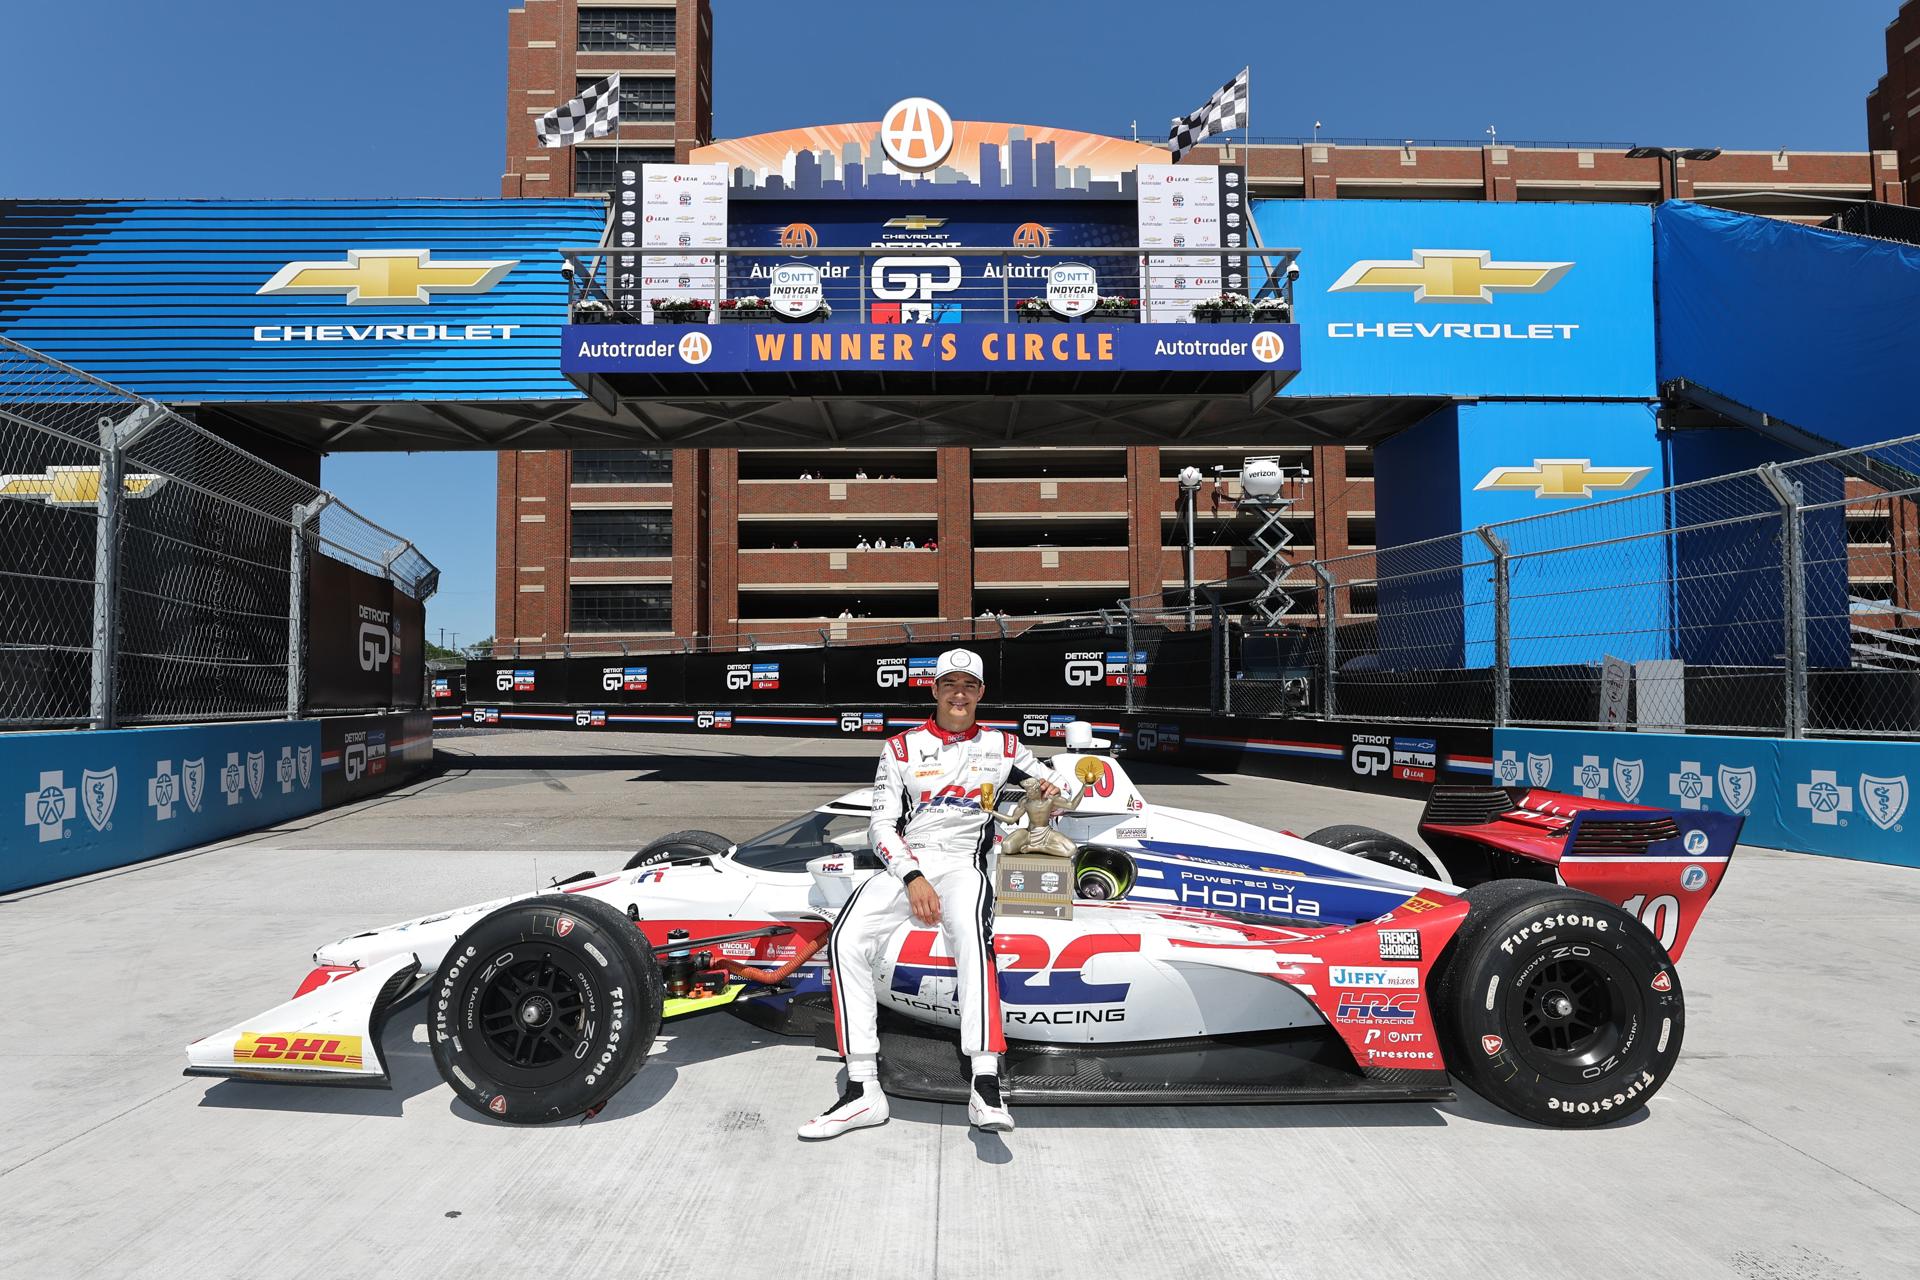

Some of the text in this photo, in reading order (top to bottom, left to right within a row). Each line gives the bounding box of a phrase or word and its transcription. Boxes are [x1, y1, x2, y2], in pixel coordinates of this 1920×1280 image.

[791, 273, 814, 282] NTT
[871, 256, 962, 300] GP
[1067, 273, 1090, 282] NTT
[773, 286, 819, 295] INDYCAR
[1049, 286, 1094, 294] INDYCAR
[253, 325, 521, 341] CHEVROLET
[1327, 322, 1580, 340] CHEVROLET
[578, 340, 675, 358] Autotrader
[755, 332, 1113, 361] WINNER'S CIRCLE
[1154, 339, 1248, 356] Autotrader
[1248, 470, 1277, 479] verizon
[359, 604, 390, 624] DETROIT
[359, 622, 391, 672] GP
[1065, 652, 1104, 660] DETROIT
[603, 673, 623, 691] GP
[727, 671, 751, 690] GP
[877, 665, 907, 688] GP
[1065, 660, 1104, 686] GP
[496, 674, 514, 691] GP
[697, 714, 714, 728] GP
[841, 717, 862, 732] GP
[1023, 719, 1049, 737] GP
[345, 731, 367, 743] DETROIT
[1352, 734, 1391, 745] DETROIT
[345, 743, 367, 782] GP
[1351, 744, 1391, 776] GP
[822, 863, 844, 872] HRC
[1181, 871, 1296, 893] Powered by
[1182, 883, 1320, 917] Honda
[1377, 932, 1418, 945] TRENCH
[1500, 913, 1609, 956] Firestone
[1379, 944, 1419, 956] SHORING
[1333, 968, 1416, 985] JIFFY mixes
[1516, 955, 1546, 988] RACING
[436, 945, 477, 1044] Firestone
[577, 972, 596, 1013] RACING
[467, 986, 480, 1030] RACING
[1336, 992, 1421, 1019] HRC
[1006, 1008, 1126, 1025] RACING
[1336, 1017, 1374, 1025] Honda
[585, 986, 625, 1086] Firestone
[1401, 1033, 1423, 1042] NTT
[252, 1036, 346, 1062] DHL
[1367, 1049, 1435, 1060] Firestone
[1548, 1071, 1655, 1115] Firestone
